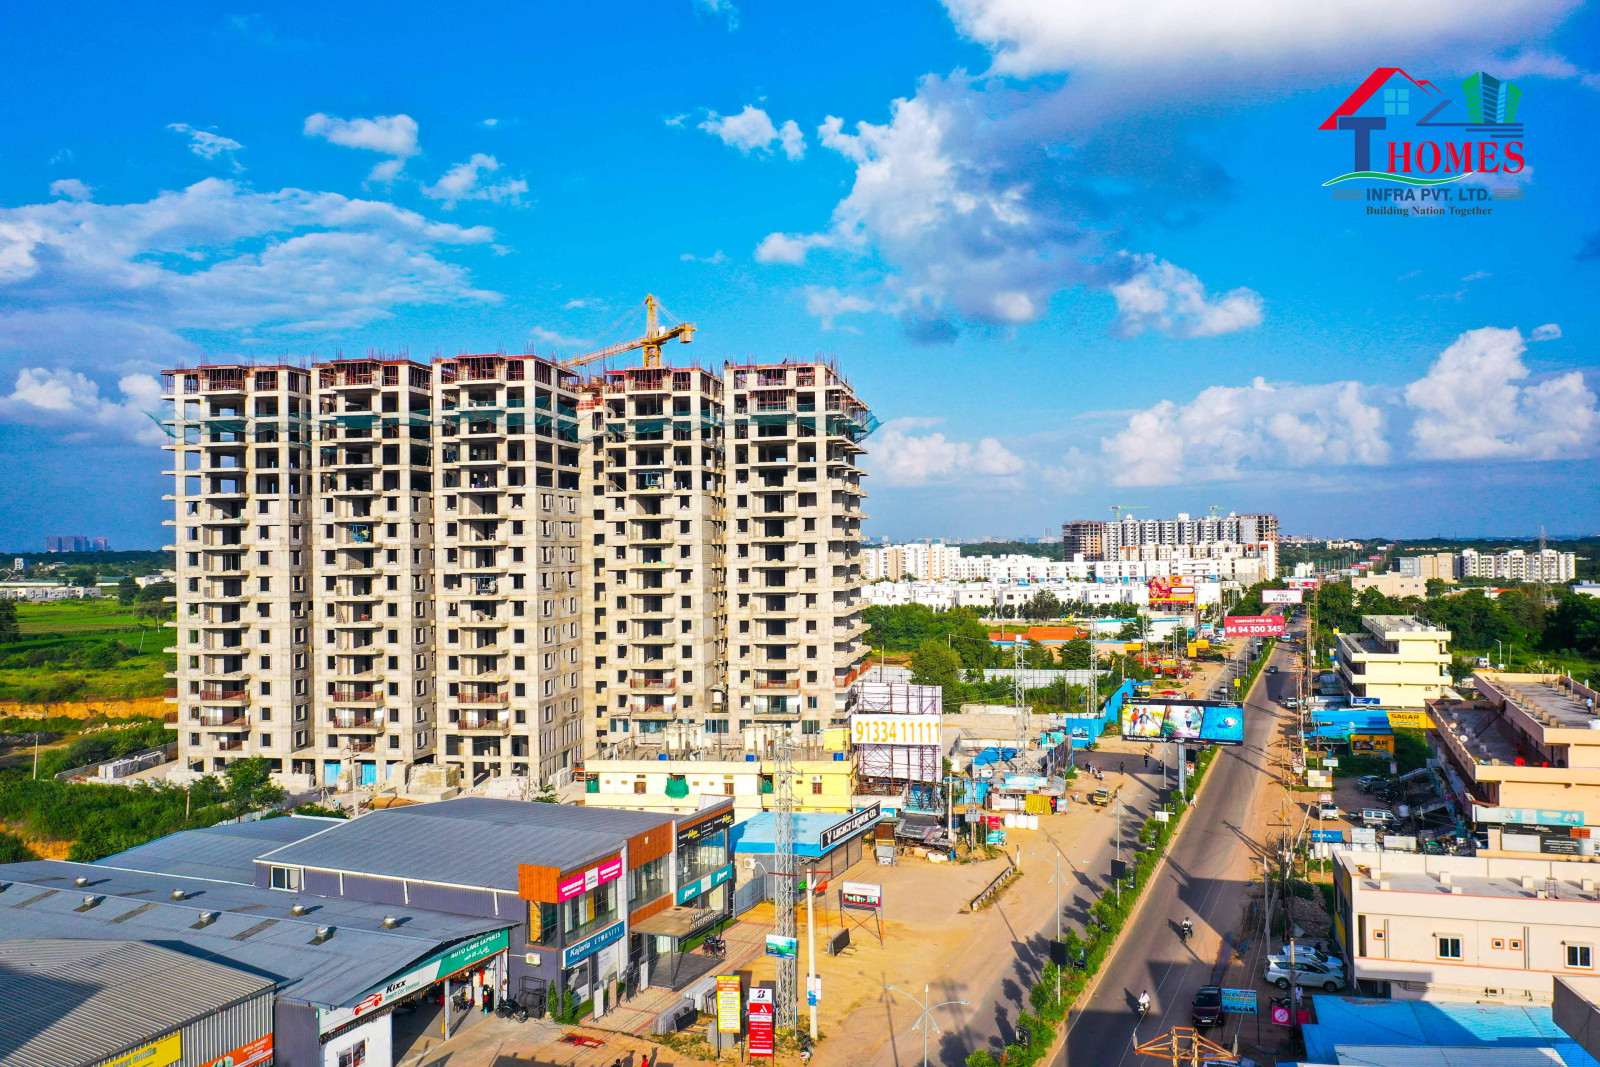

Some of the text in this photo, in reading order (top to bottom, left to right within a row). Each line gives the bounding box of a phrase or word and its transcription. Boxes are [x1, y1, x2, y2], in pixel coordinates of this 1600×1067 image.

[1226, 626, 1237, 634] 94
[1238, 626, 1248, 634] 94
[1250, 625, 1266, 633] 300
[855, 720, 940, 743] 91334 11111
[450, 947, 466, 960] AUTO
[466, 942, 480, 952] CARE
[479, 931, 501, 946] EXPERTS
[385, 978, 407, 995] Kixx
